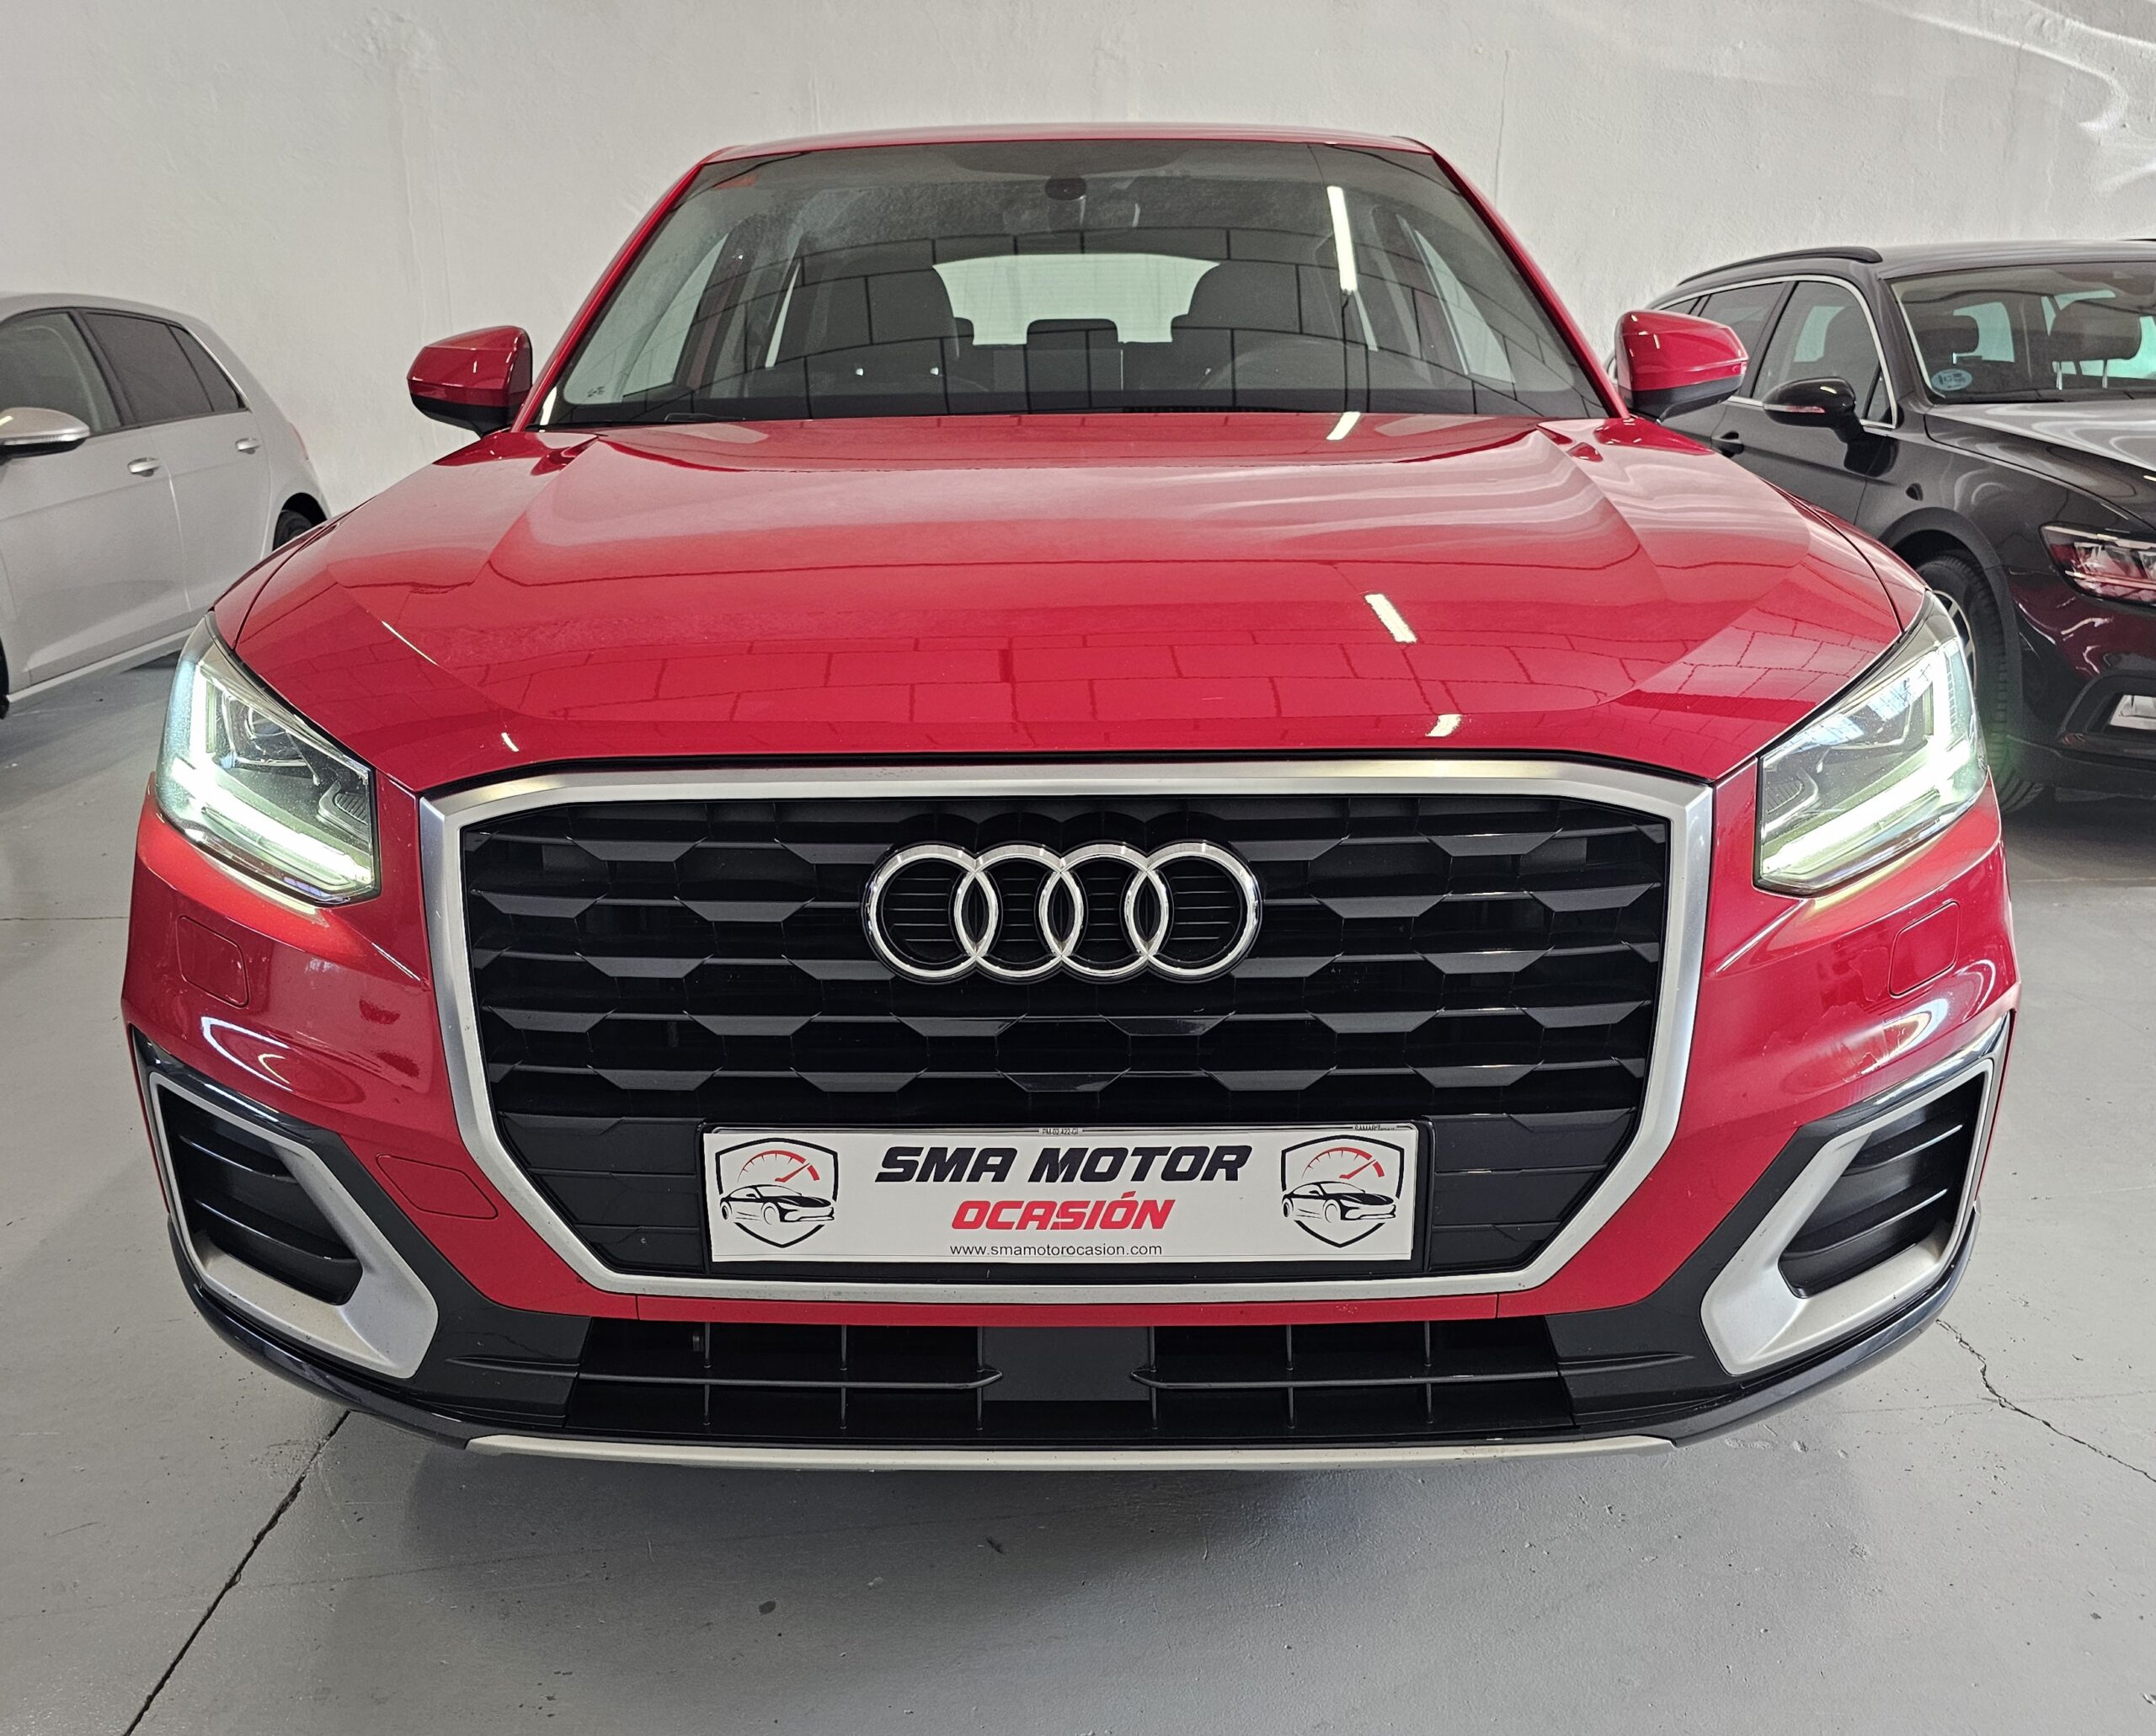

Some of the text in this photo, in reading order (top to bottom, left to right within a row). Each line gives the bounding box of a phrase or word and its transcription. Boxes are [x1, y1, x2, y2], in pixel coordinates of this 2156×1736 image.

[875, 1146, 1252, 1183] SMA MOTOR
[952, 1191, 1175, 1230] OCASIÓN
[950, 1243, 1161, 1255] www.smamotorocasion.com
